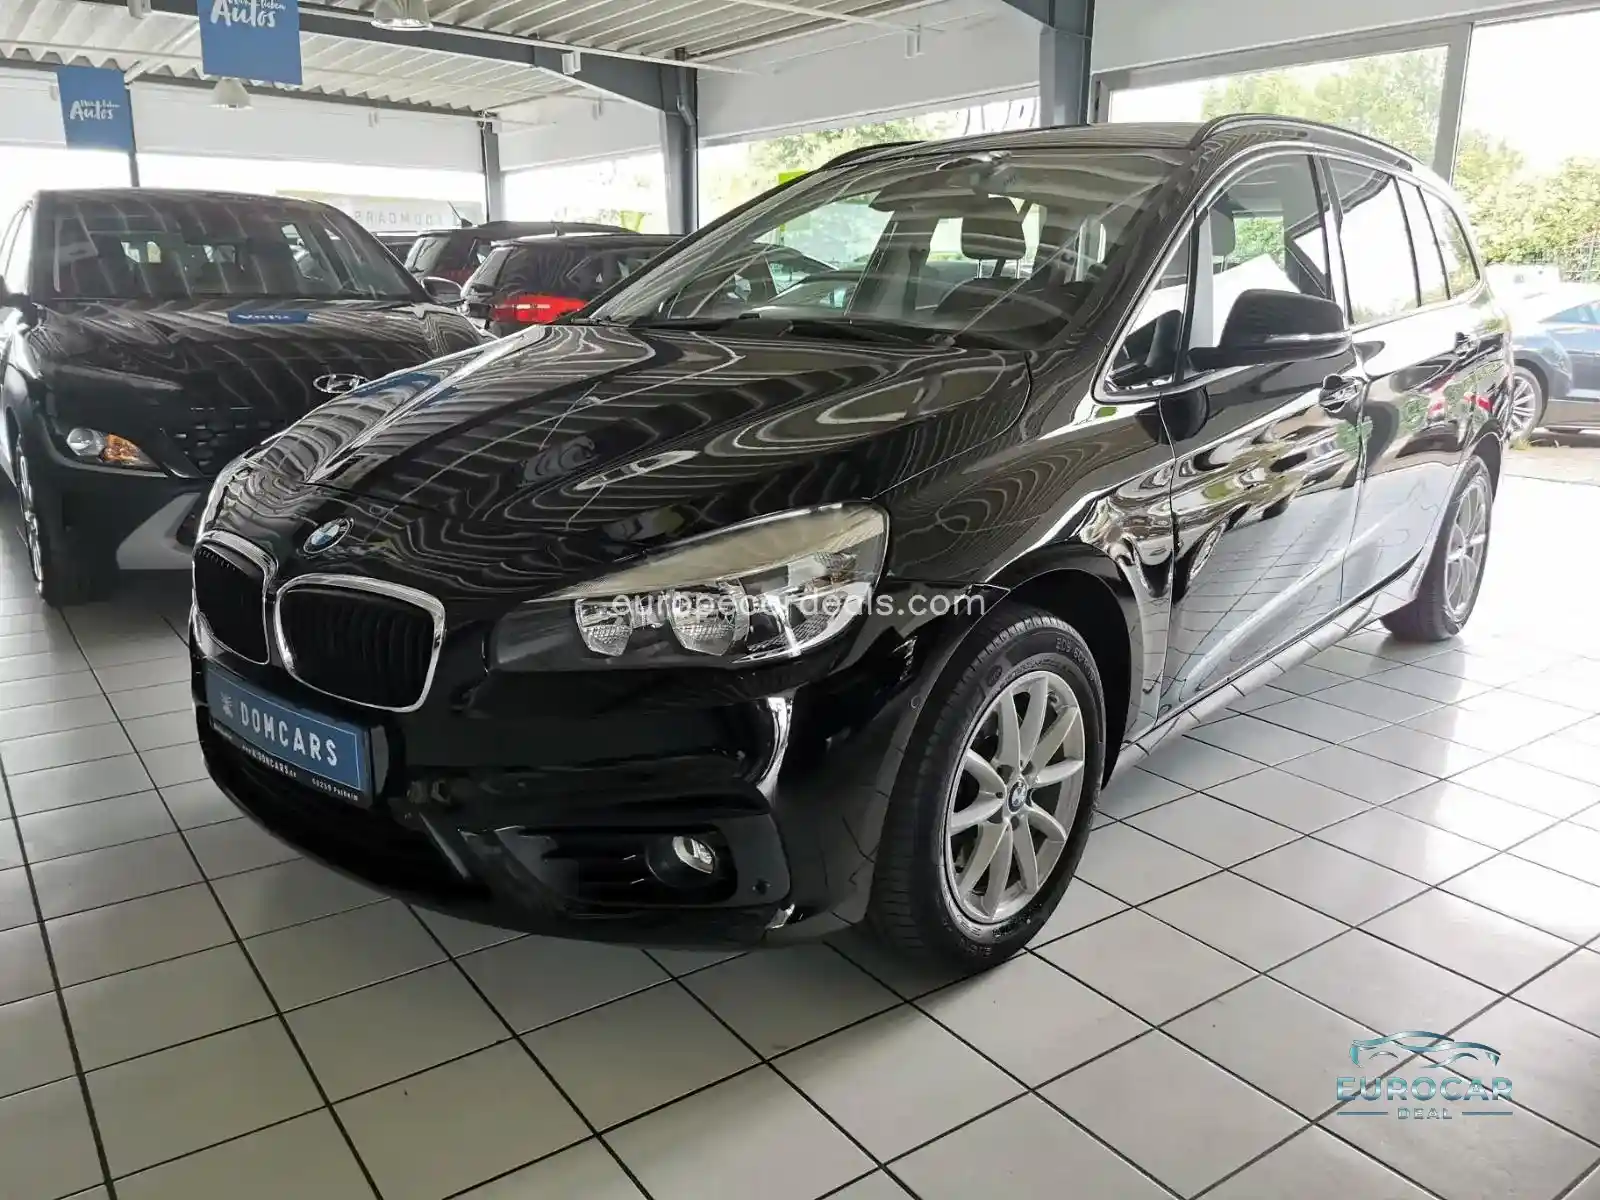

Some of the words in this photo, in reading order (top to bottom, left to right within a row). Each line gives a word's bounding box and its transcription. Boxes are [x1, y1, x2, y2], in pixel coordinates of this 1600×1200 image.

[210, 0, 276, 27] Autos
[69, 100, 114, 121] Autos
[240, 701, 338, 766] DOMCARS
